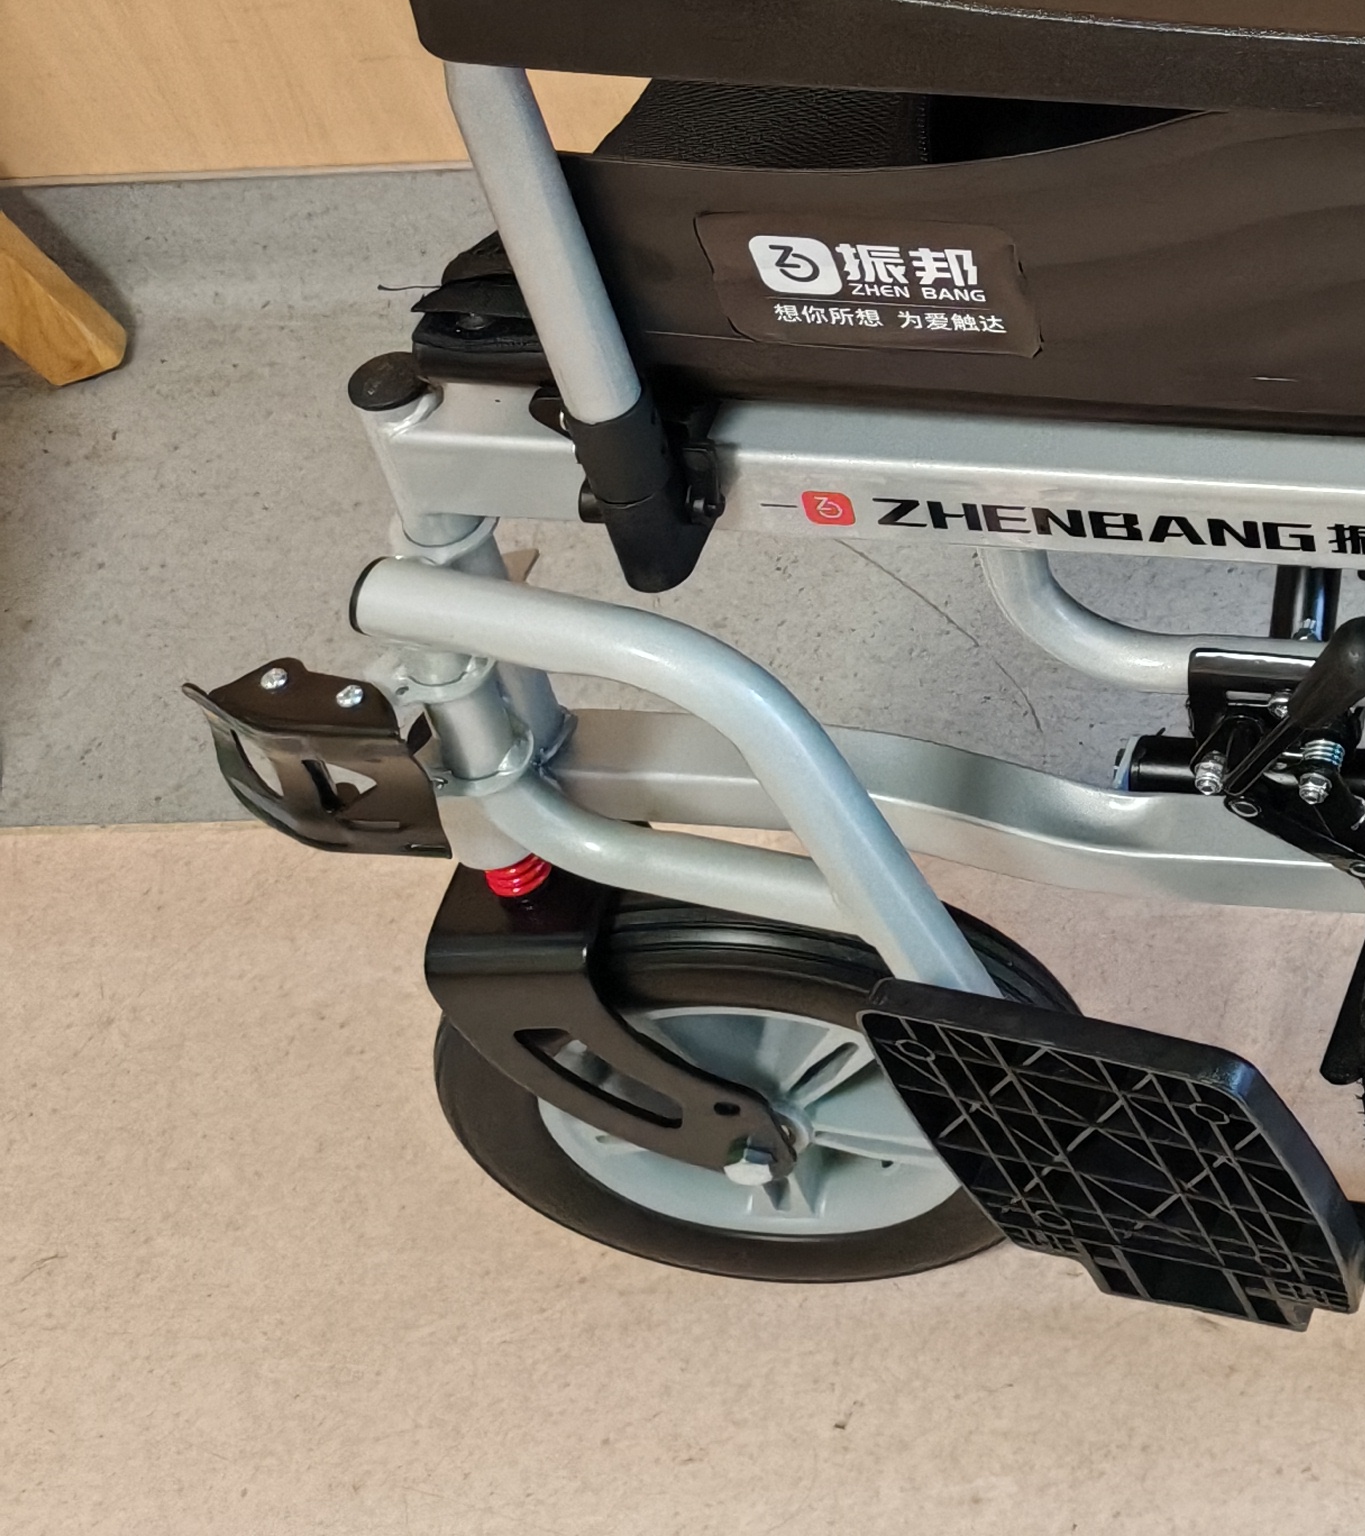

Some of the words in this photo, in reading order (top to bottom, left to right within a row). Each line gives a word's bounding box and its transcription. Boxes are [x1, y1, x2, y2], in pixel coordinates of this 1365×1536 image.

[835, 243, 978, 286] 振邦
[851, 283, 910, 298] ZHEN
[921, 287, 987, 302] BANG
[774, 303, 883, 327] 想你所想
[897, 310, 1007, 333] 为爱触达
[872, 497, 1318, 553] ZHENBANG
